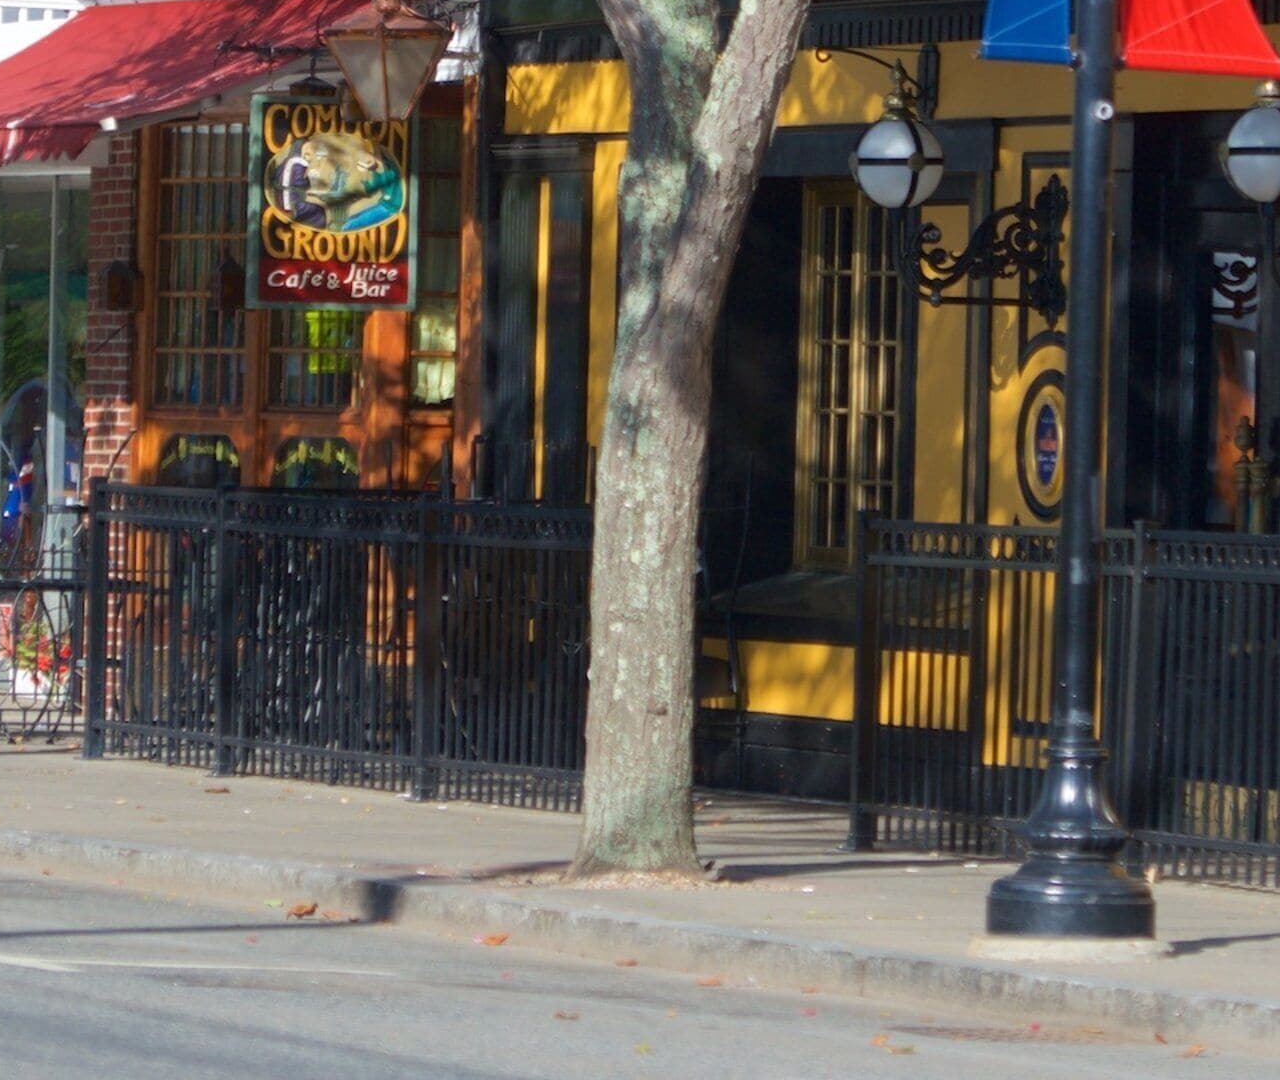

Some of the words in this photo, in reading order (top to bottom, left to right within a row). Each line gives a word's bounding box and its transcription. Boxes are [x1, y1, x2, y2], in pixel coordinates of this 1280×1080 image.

[262, 206, 407, 263] GROUND
[267, 270, 324, 290] Café
[326, 275, 340, 289] &
[343, 264, 398, 284] Juice
[351, 281, 390, 298] Bar
